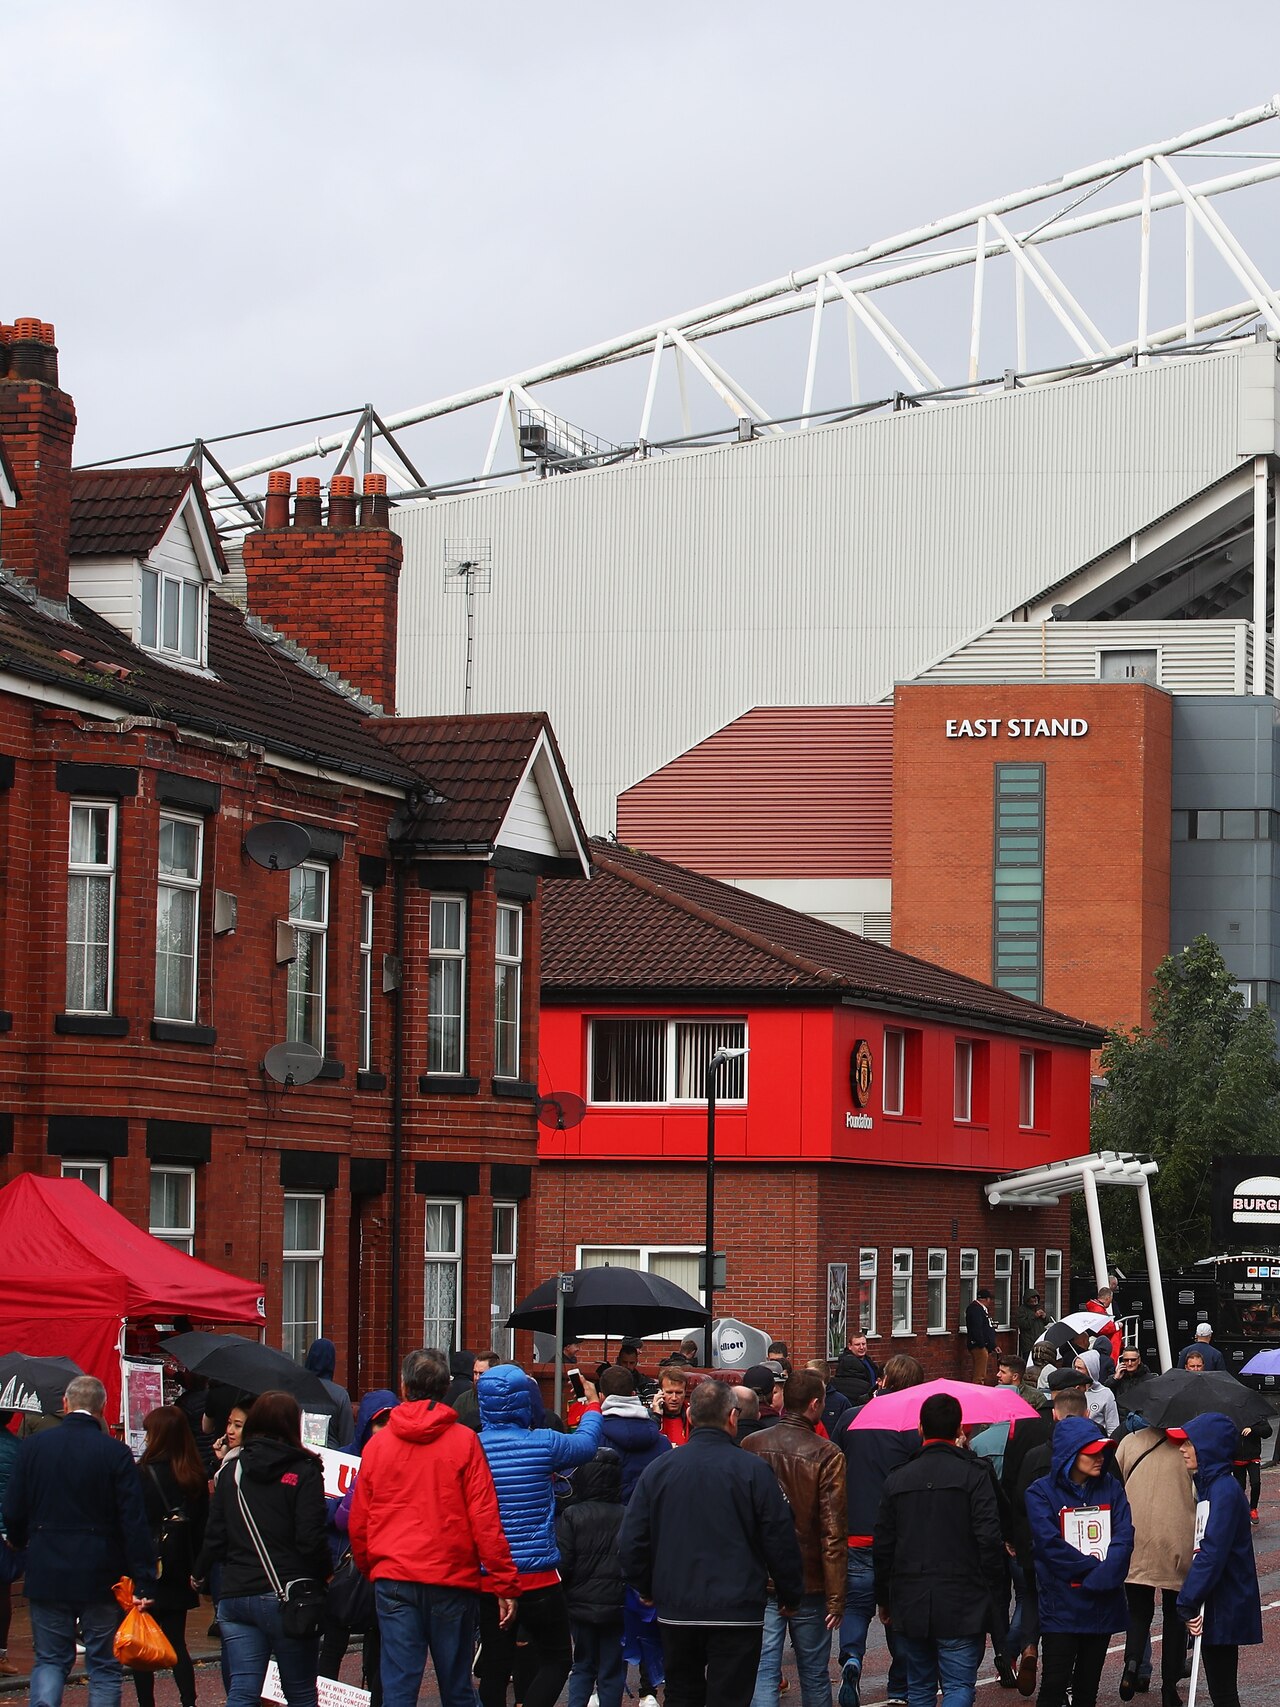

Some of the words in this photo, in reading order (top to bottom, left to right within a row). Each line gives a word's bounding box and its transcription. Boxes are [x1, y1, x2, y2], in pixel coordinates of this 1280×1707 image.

[945, 719, 1002, 738] EAST
[1007, 718, 1089, 737] STAND
[846, 1111, 873, 1130] Foundation
[320, 1681, 331, 1690] FIVE
[330, 1692, 342, 1702] GOAL
